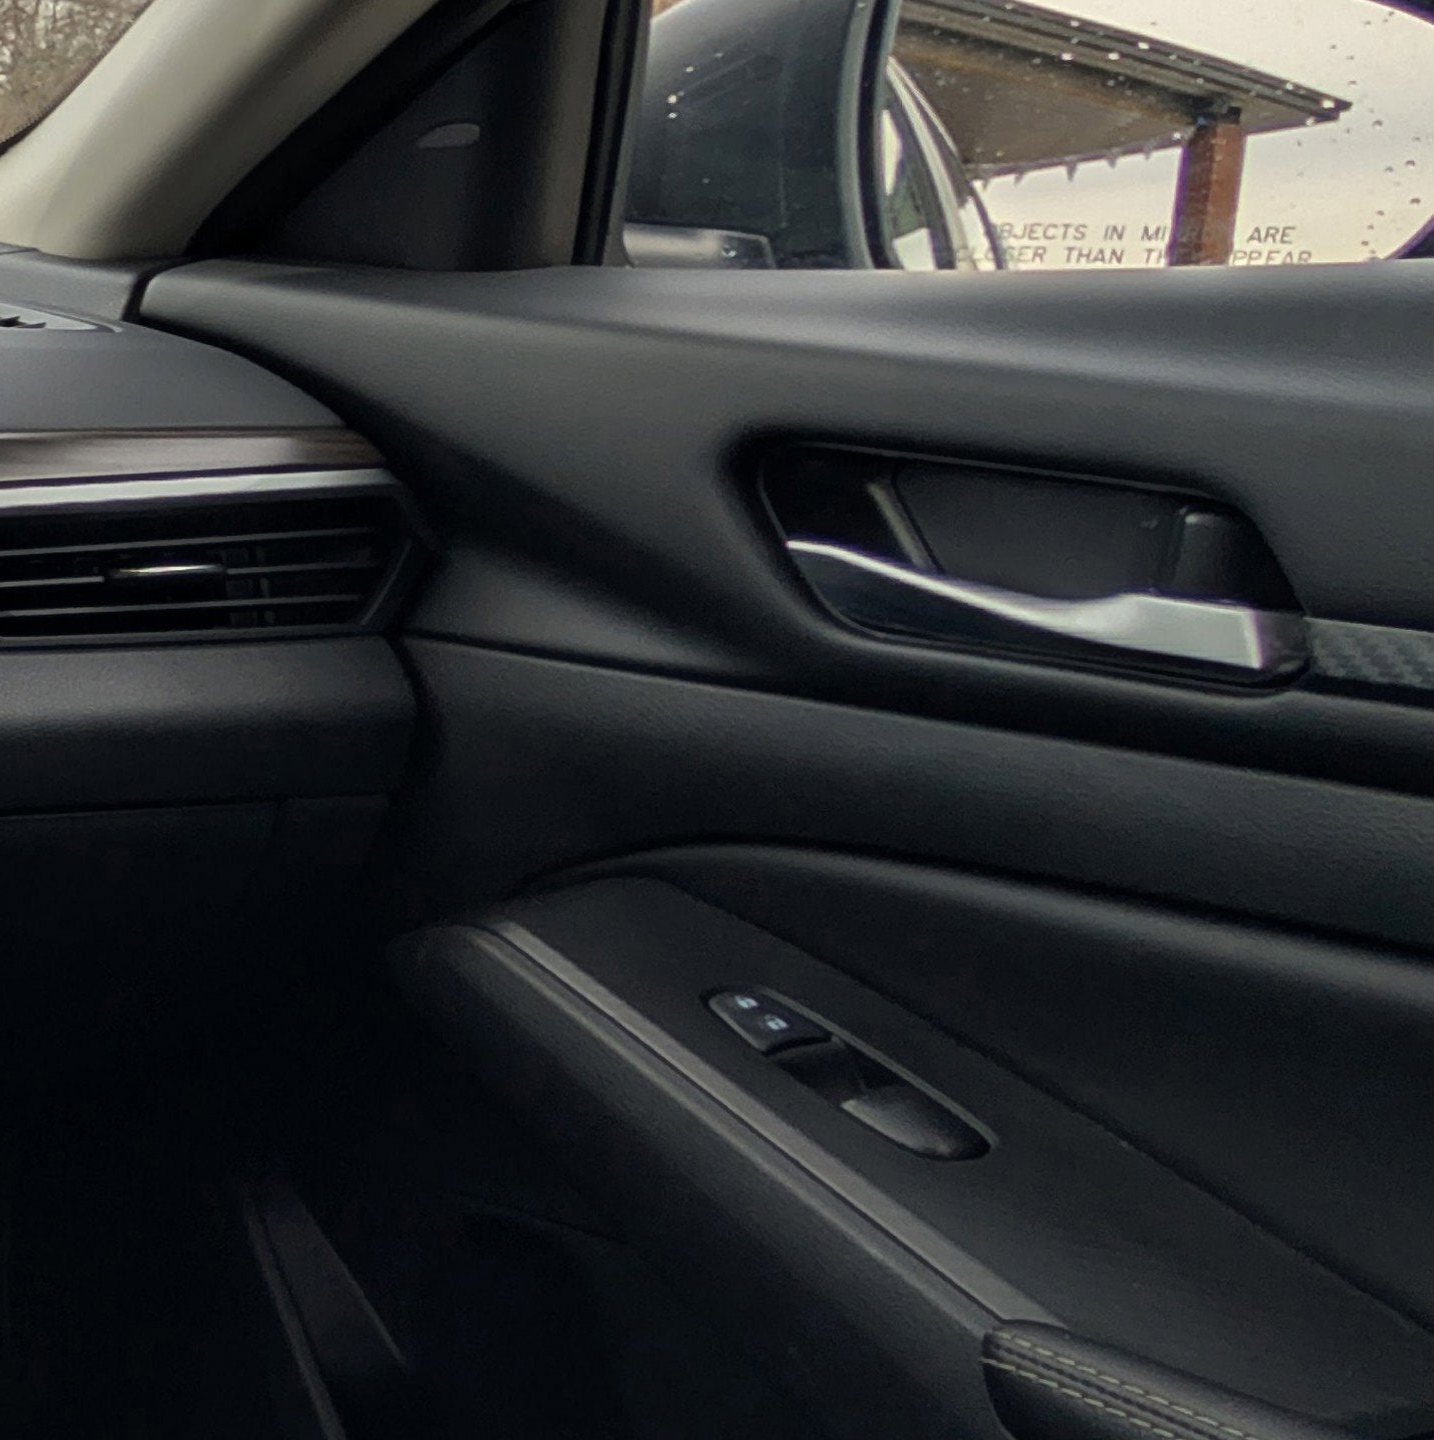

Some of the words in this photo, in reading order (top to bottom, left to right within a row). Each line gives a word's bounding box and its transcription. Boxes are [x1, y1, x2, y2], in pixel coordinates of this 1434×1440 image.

[1103, 224, 1126, 241] IN
[1246, 226, 1297, 244] ARE
[1065, 248, 1125, 265] THAN
